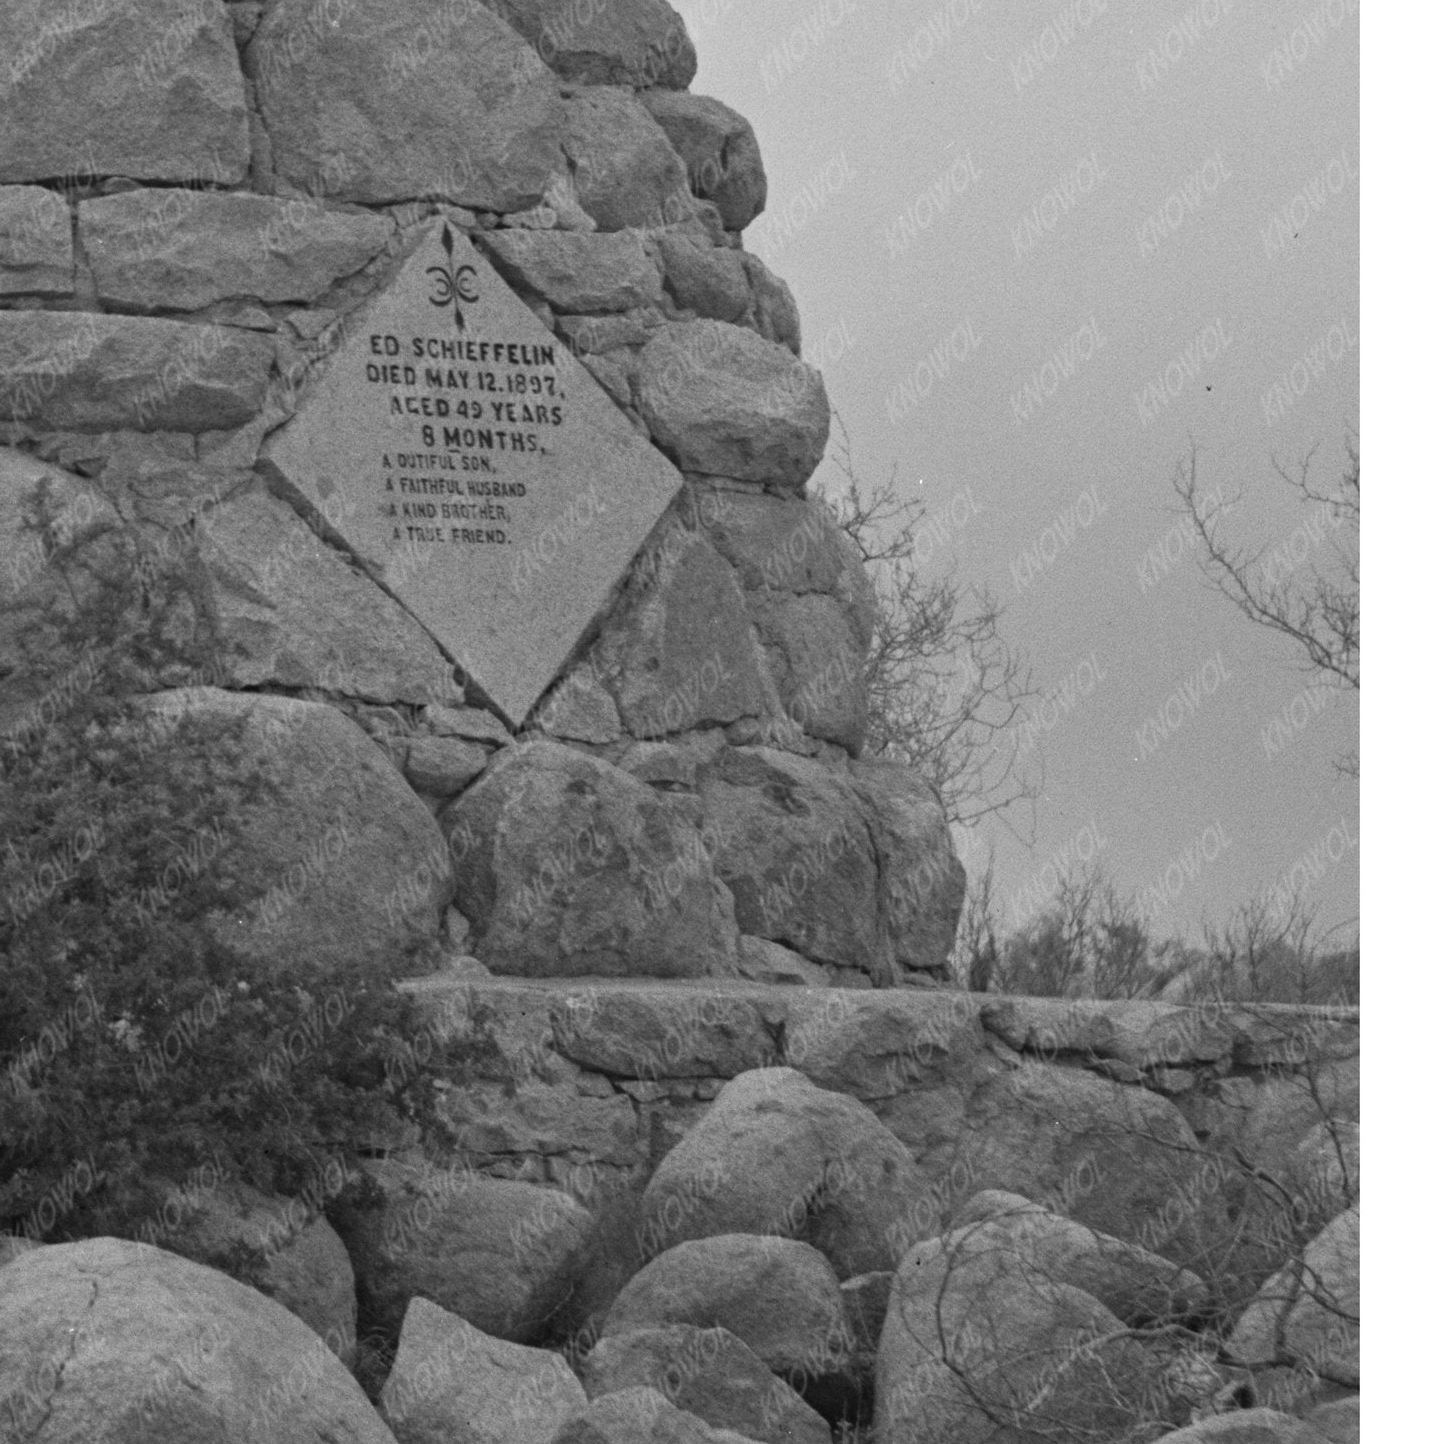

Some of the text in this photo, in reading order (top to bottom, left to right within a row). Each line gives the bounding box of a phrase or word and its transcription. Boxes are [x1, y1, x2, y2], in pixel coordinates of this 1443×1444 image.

[370, 335, 555, 365] ED SCHIEFFELIN
[366, 364, 416, 386] DIED
[425, 368, 469, 389] MAY
[391, 396, 563, 426] AGED 49 YEARS
[422, 425, 435, 447] 8
[382, 454, 392, 469] A
[397, 453, 456, 470] DUTIFUL
[386, 478, 394, 491] A
[400, 477, 464, 495] FAITHFUL
[389, 503, 397, 517] A
[402, 502, 437, 519] KIND
[392, 527, 401, 540] A
[406, 526, 445, 543] TRUE
